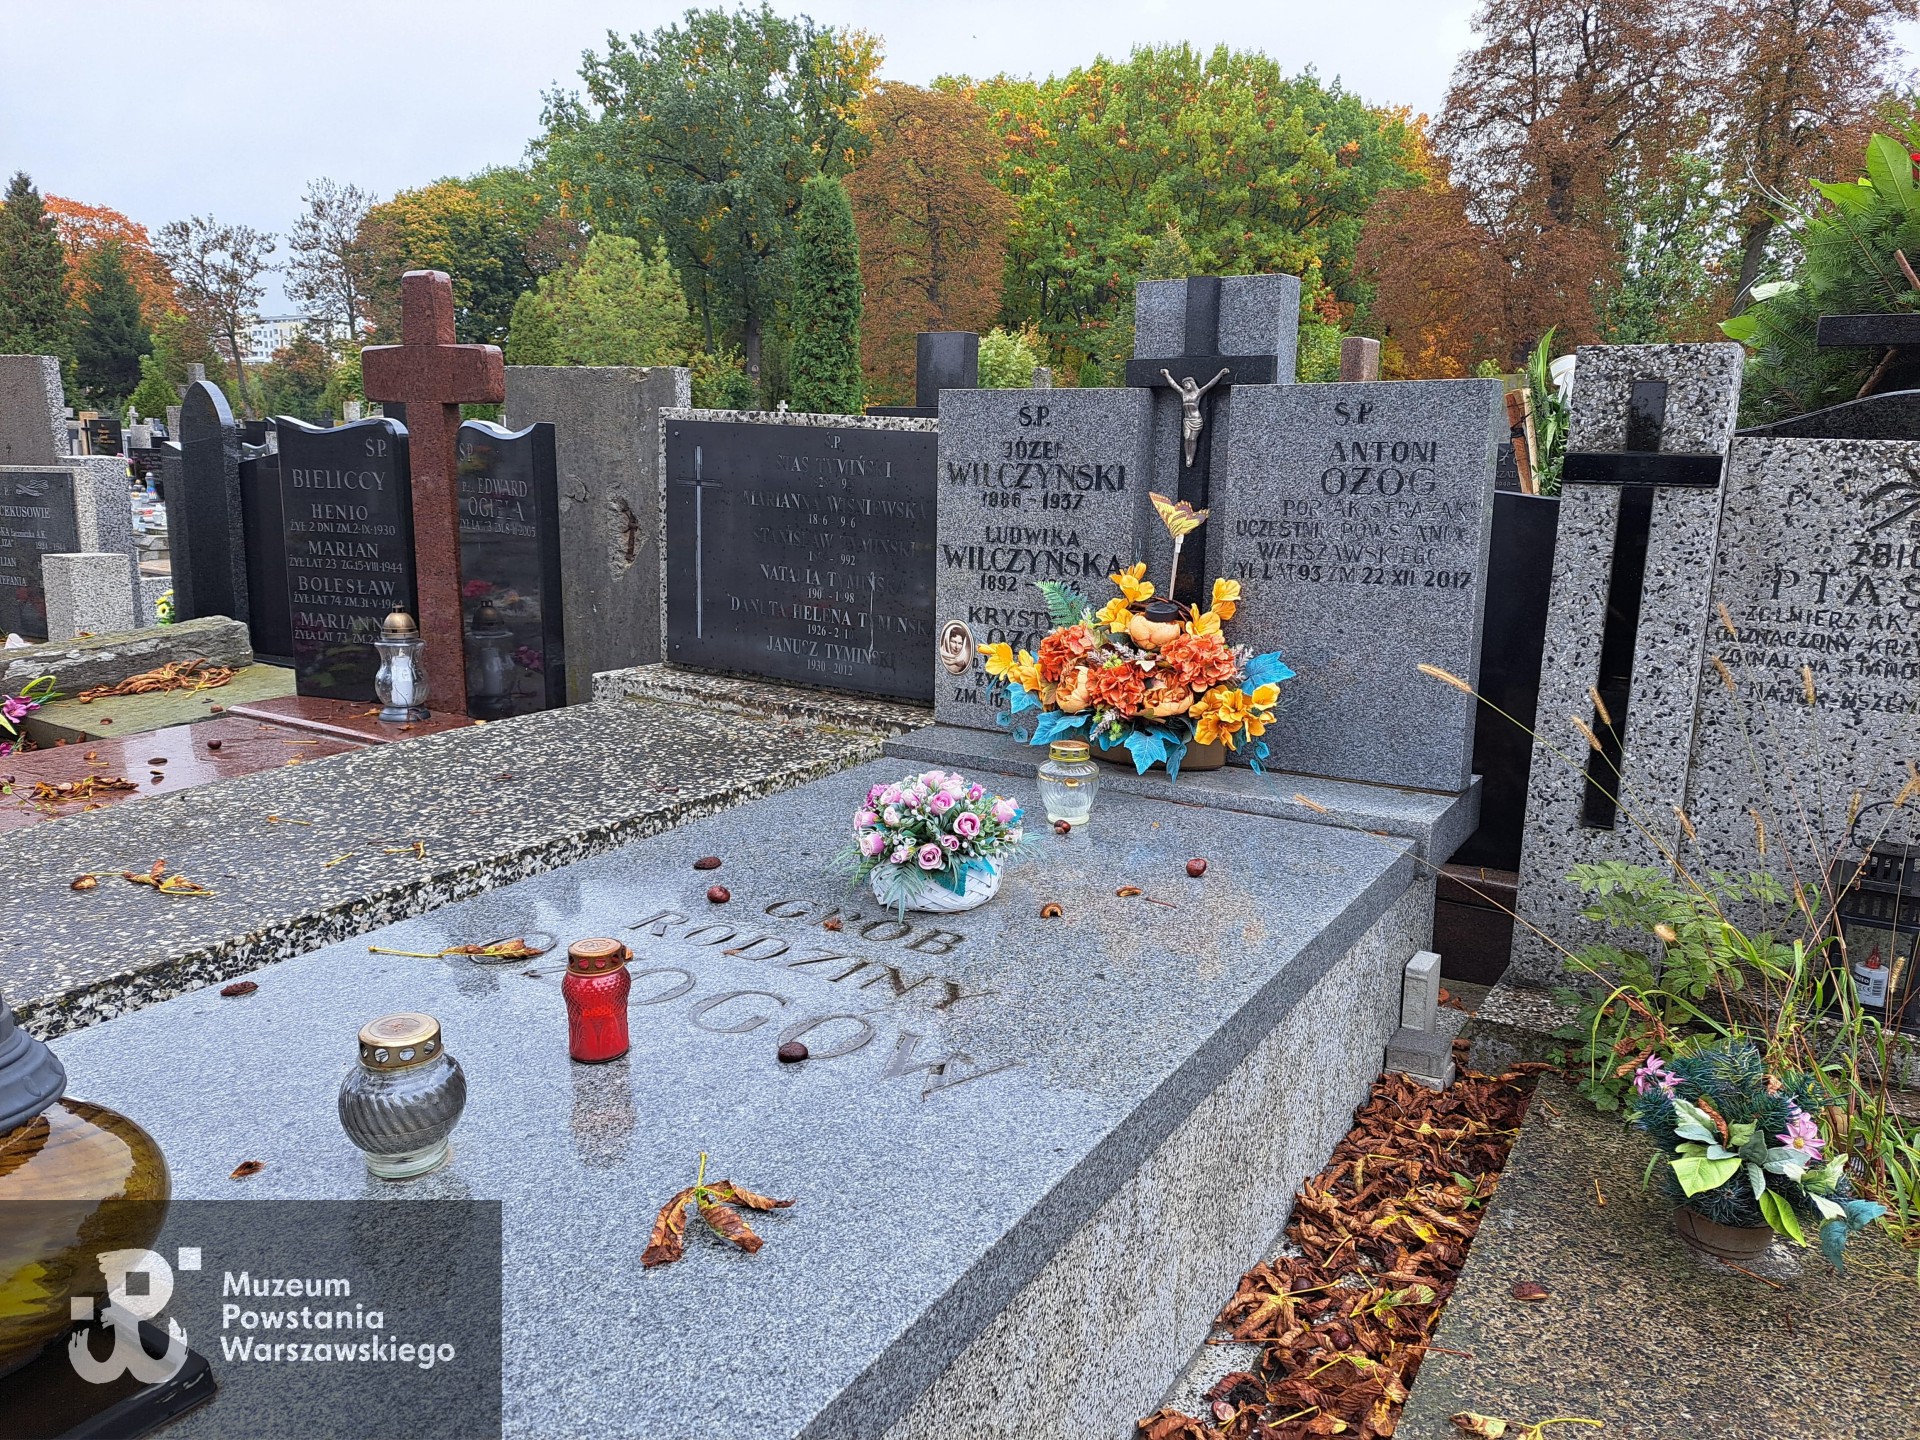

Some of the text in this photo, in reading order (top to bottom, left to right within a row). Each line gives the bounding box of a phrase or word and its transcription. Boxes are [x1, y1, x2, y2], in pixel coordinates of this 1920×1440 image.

[1329, 441, 1437, 463] ANTONI
[291, 468, 386, 491] BIELICCY
[477, 477, 528, 498] EDWARD
[311, 503, 368, 521] HENIO
[309, 521, 315, 532] 2
[317, 522, 334, 533] DNI
[985, 526, 1081, 547] LUDWIKA
[308, 540, 379, 559] MARIAN
[306, 557, 323, 569] LAT
[325, 559, 337, 570] 23
[297, 575, 396, 596] BOLESŁAW
[980, 573, 1018, 592] 1892
[1298, 565, 1322, 583] 93
[1361, 566, 1384, 585] 22
[1424, 569, 1473, 590] 2017
[312, 594, 328, 605] LAT
[330, 595, 341, 606] 74
[300, 611, 383, 632] MARIANN
[792, 603, 852, 626] HELENA
[318, 630, 334, 642] LAT
[337, 631, 347, 643] 73
[807, 623, 827, 637] 1926
[766, 635, 819, 657] JANUSZ
[807, 658, 826, 672] 1930
[626, 909, 1001, 1010] RODZINY
